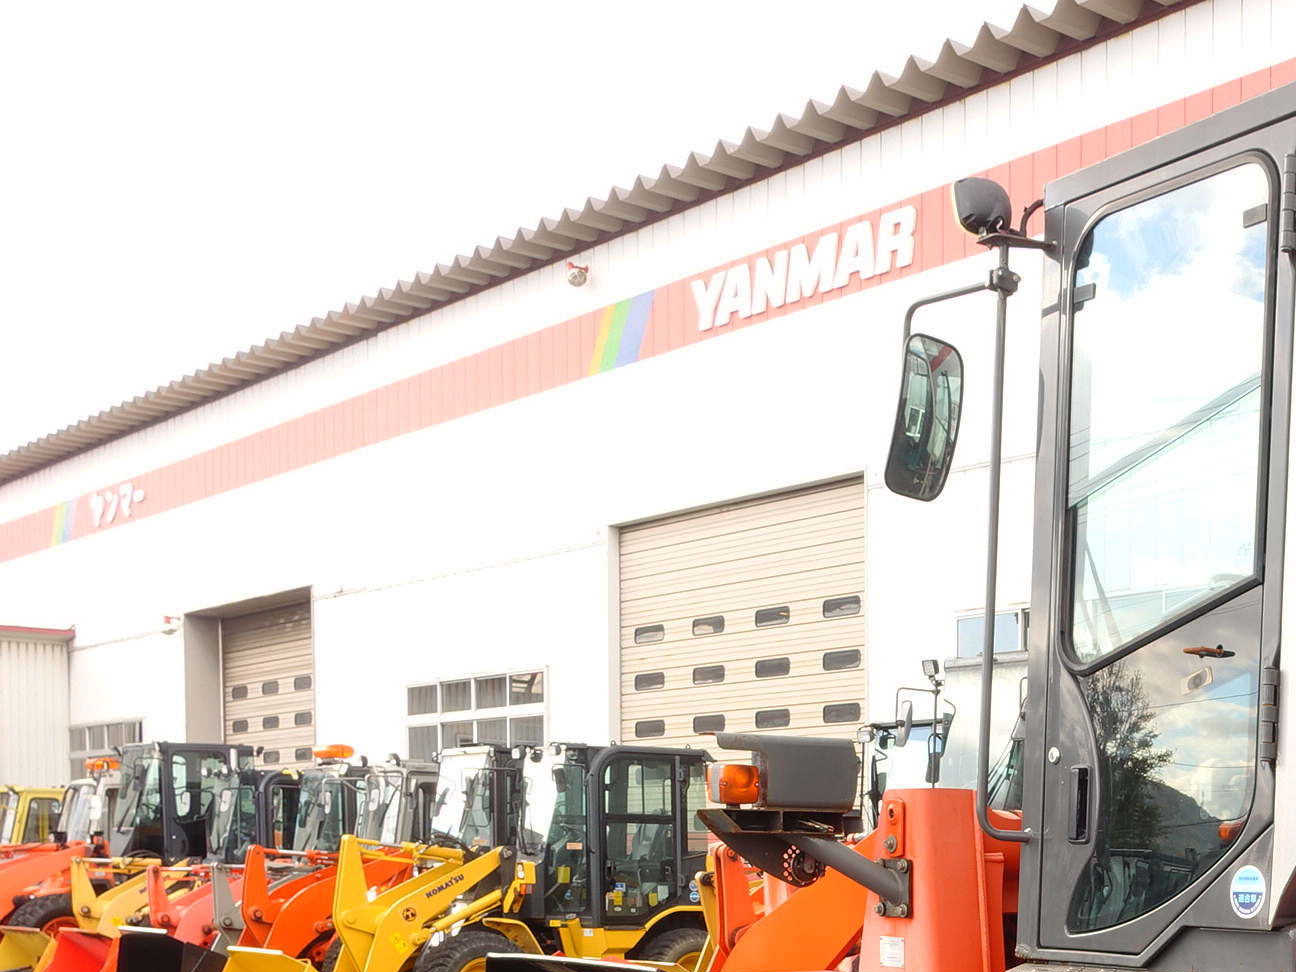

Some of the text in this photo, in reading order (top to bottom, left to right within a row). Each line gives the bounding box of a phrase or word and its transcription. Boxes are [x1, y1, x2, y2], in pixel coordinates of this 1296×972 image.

[690, 205, 917, 331] YANMAR
[90, 482, 146, 528] ヤンマー
[425, 873, 465, 899] KOMATSU
